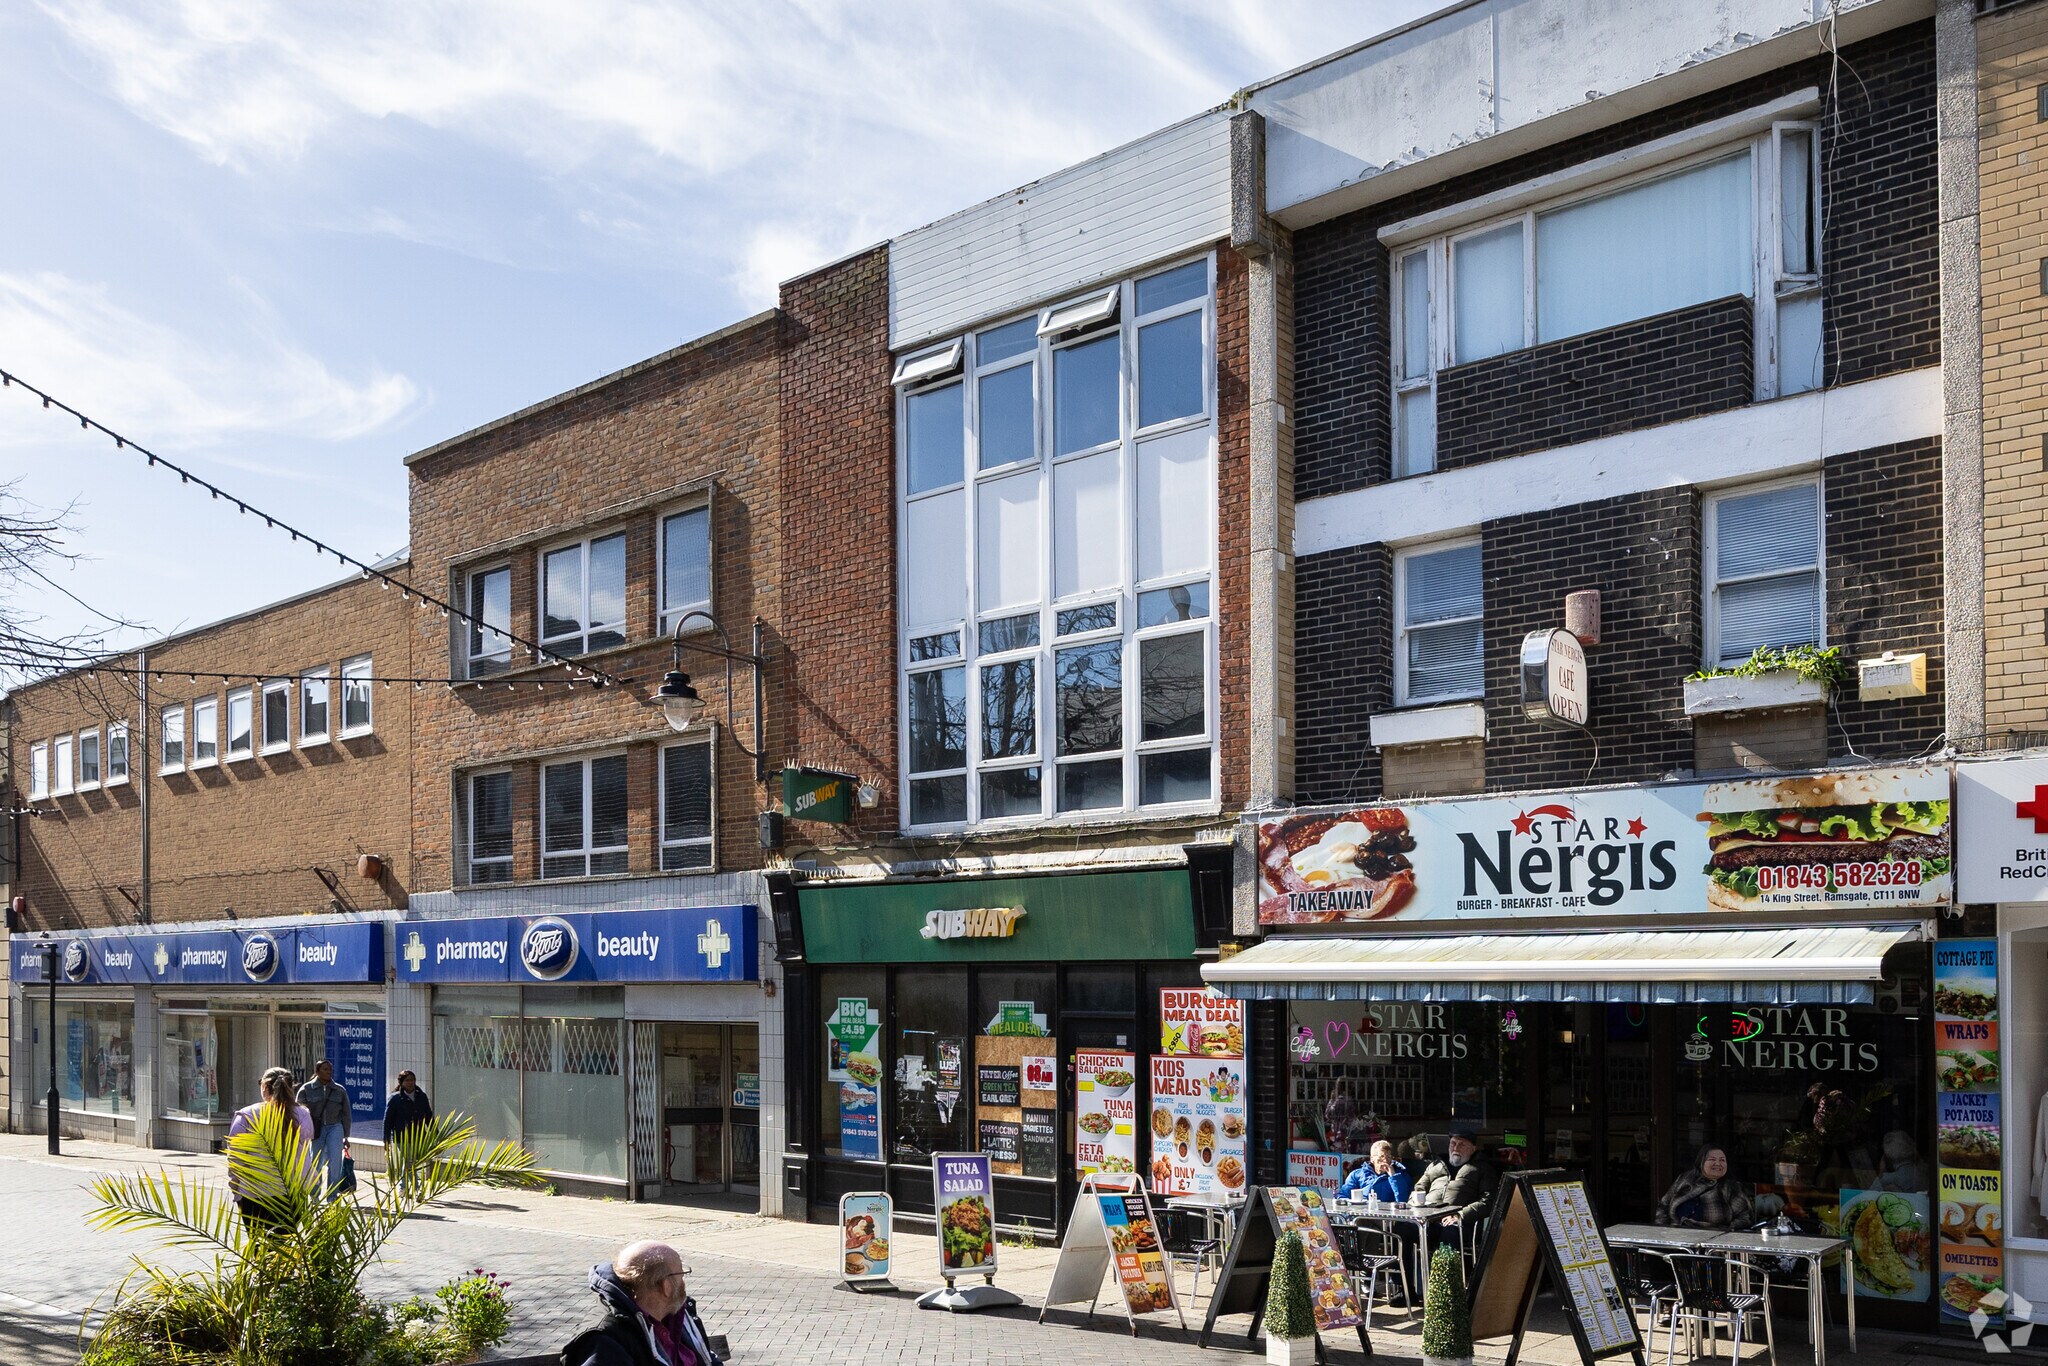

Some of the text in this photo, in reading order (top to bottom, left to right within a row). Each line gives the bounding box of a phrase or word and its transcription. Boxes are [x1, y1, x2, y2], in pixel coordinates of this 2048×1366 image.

[1552, 693, 1583, 723] OPEN
[794, 780, 840, 813] SUBWAY
[1531, 817, 1620, 843] STAR
[2016, 848, 2048, 861] Brit
[1456, 830, 1677, 906] Nergis
[2000, 865, 2048, 879] RedC
[1758, 861, 1922, 891] 01843 582328
[1288, 889, 1374, 913] TAKEAWAY
[1457, 900, 1492, 911] BURGER
[1501, 897, 1553, 909] BREAKFAST
[1562, 896, 1586, 908] CAFE
[1760, 894, 1770, 903] 14
[1773, 894, 1791, 905] King
[1824, 891, 1871, 903] Ramsgate,
[1873, 891, 1895, 901] CT11
[1899, 889, 1920, 900] 8NW
[920, 904, 1027, 939] SUBWAY
[437, 936, 508, 965] pharmacy
[598, 930, 659, 962] beauty
[104, 949, 133, 970] beauty
[181, 948, 227, 970] pharmacy
[300, 942, 337, 967] beauty
[1937, 951, 1994, 966] COTTAGE PIE
[1164, 993, 1239, 1009] BURGER
[841, 1002, 865, 1017] BIG
[1164, 1010, 1240, 1022] MEAL DEAL
[1369, 1004, 1446, 1030] STAR
[1747, 1007, 1850, 1037] STAR
[339, 1025, 372, 1037] welcome
[841, 1025, 865, 1035] £4.59
[990, 1021, 1041, 1037] MEAL DEAL
[1502, 1018, 1522, 1035] Coffee
[1945, 1024, 1988, 1040] WRAPS
[350, 1042, 372, 1051] pharmacy
[1290, 1036, 1320, 1058] Coffee
[1351, 1033, 1468, 1059] NERGIS
[357, 1054, 372, 1063] beauty
[1079, 1056, 1124, 1067] CHICKEN
[1721, 1040, 1879, 1072] NERGIS
[345, 1065, 355, 1073] food
[1079, 1065, 1104, 1074] SALAD
[1154, 1060, 1184, 1077] KIDS
[980, 1071, 1018, 1080] FILTER Coffee
[345, 1078, 356, 1087] baby
[983, 1083, 1017, 1092] GREEN TEA
[1154, 1078, 1201, 1096] MEALS
[359, 1091, 373, 1099] photo
[982, 1093, 1016, 1103] EARL GREY
[1950, 1093, 1987, 1106] JACKET
[352, 1102, 373, 1111] electrical
[1103, 1100, 1133, 1111] TUNA
[1026, 1113, 1049, 1124] PANINI
[1107, 1110, 1133, 1119] SALAD
[1944, 1109, 1994, 1122] POTATOES
[980, 1124, 1018, 1136] CAPPUCCINO
[988, 1137, 1011, 1149] LATTE
[1023, 1133, 1054, 1143] SANDWICH
[1079, 1143, 1104, 1155] FETA
[1079, 1154, 1104, 1163] SALAD
[1290, 1154, 1338, 1166] WELCOME TO
[945, 1162, 979, 1175] TUNA
[1174, 1166, 1195, 1178] ONLY
[1304, 1166, 1324, 1177] STAR
[944, 1178, 983, 1193] SALAD
[1178, 1179, 1185, 1190] £
[1320, 1179, 1338, 1189] CAFE
[1942, 1174, 1998, 1192] ON TOASTS
[1945, 1252, 1998, 1267] OMELETTES
